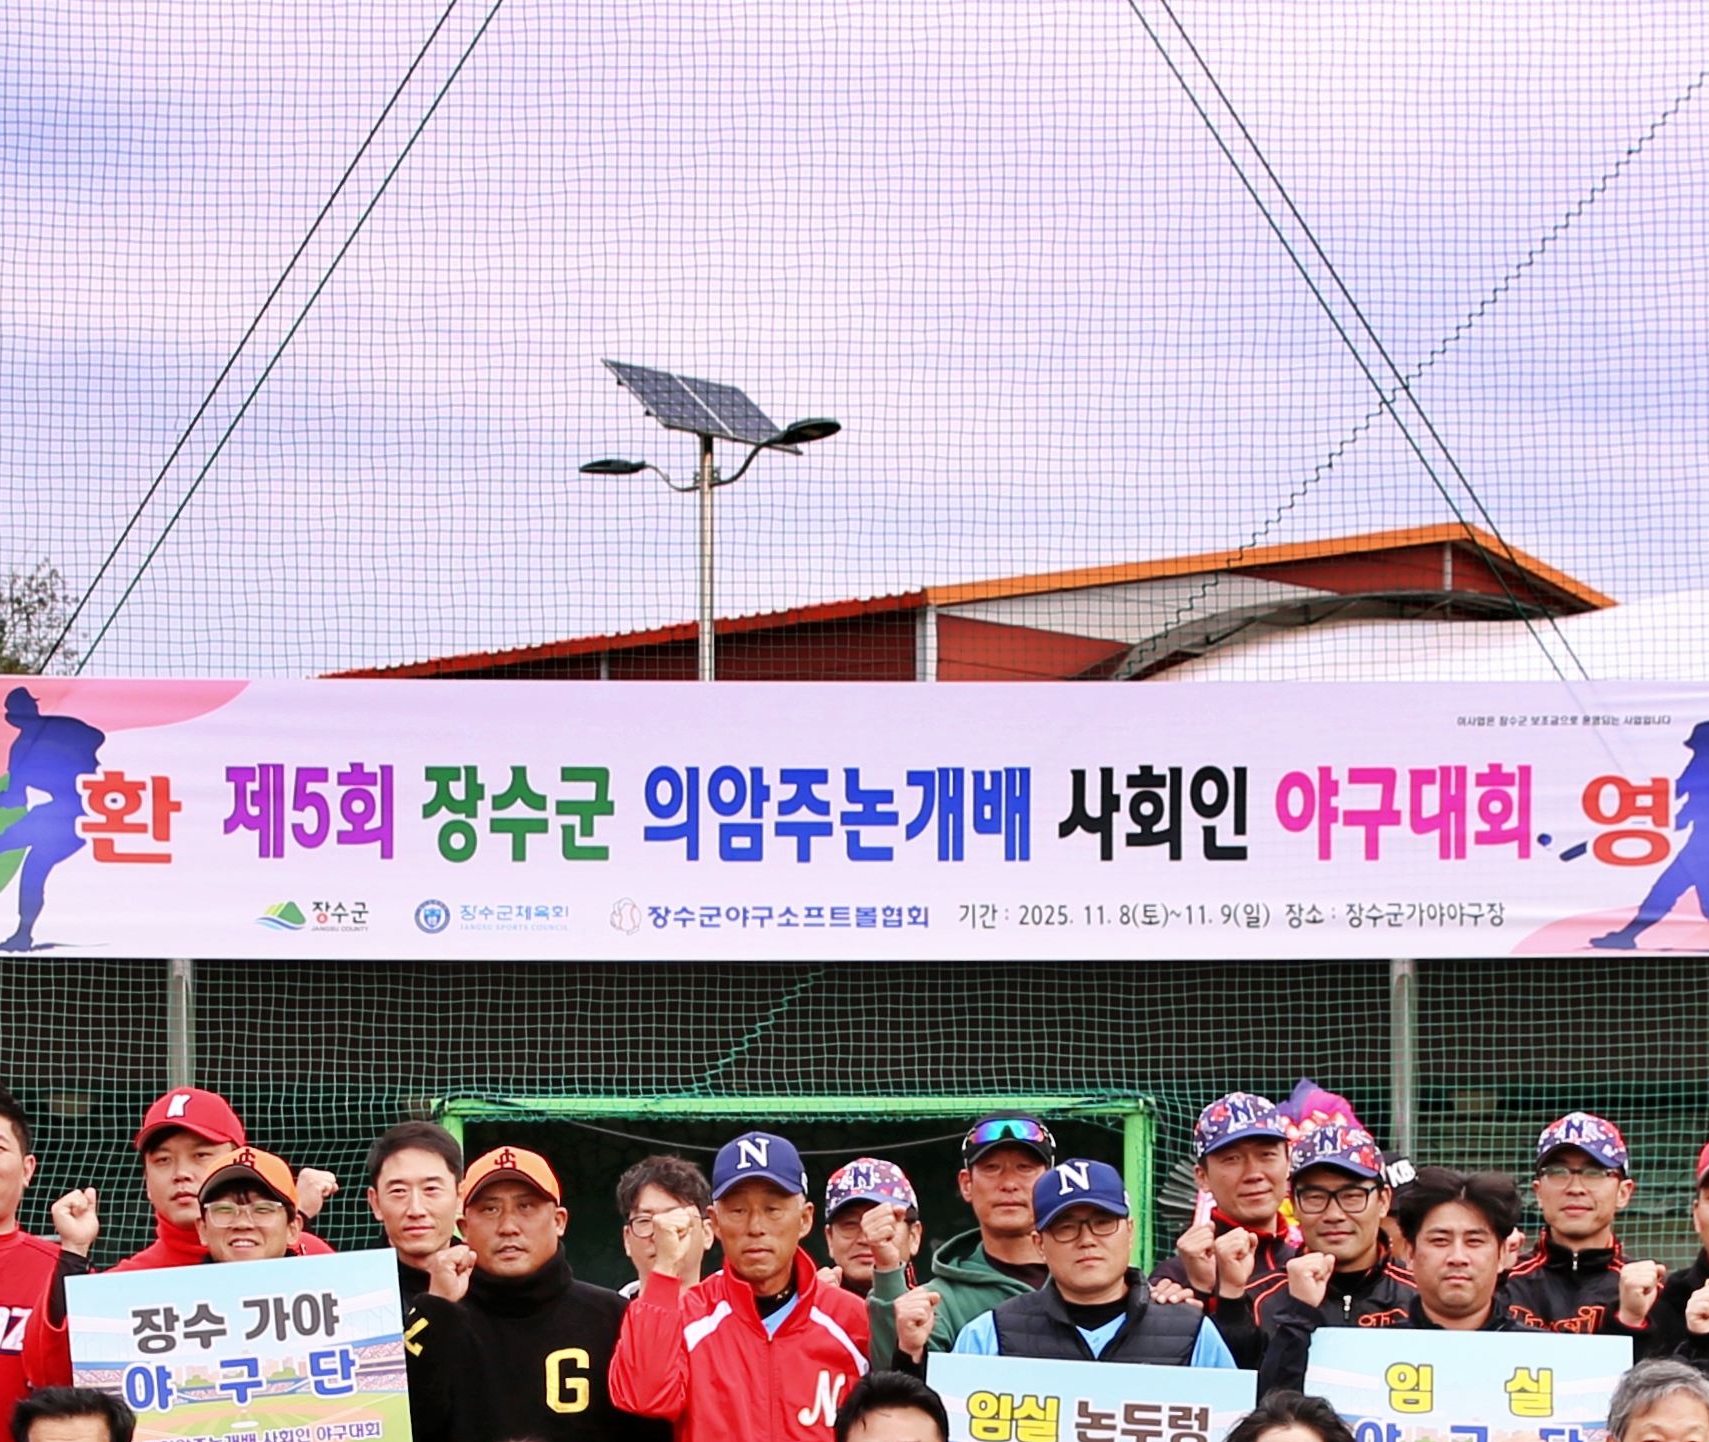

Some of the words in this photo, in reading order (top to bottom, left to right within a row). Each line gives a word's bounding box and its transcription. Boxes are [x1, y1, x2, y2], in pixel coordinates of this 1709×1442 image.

[1499, 715, 1527, 727] 장수군
[1530, 715, 1579, 727] 보조금으로
[1581, 714, 1621, 726] 운영되는
[1623, 714, 1672, 726] 사업입니다
[80, 770, 183, 864] 환
[223, 762, 395, 860] 제5회
[421, 764, 615, 862] 장수군
[643, 764, 1032, 862] 의암주논개배
[1057, 764, 1249, 862] 사회인
[1274, 762, 1534, 861] 야구대회
[1580, 774, 1672, 867] 영
[311, 901, 370, 924] 장수군
[459, 904, 570, 922] 장수군체육회
[647, 905, 930, 928] 장수군야구소프트볼협회
[959, 903, 999, 929] 기간
[1018, 904, 1075, 925] 2025.
[1083, 904, 1112, 925] 11.
[1220, 902, 1271, 928] 9(일)
[1285, 902, 1325, 928] 장소
[1344, 902, 1506, 928] 장수군가야야구장
[529, 923, 570, 931] COUNCIL
[166, 1094, 192, 1117] K
[1228, 1098, 1257, 1124] N
[1315, 1127, 1342, 1154] N
[1561, 1118, 1587, 1142] N
[736, 1137, 771, 1170] N
[850, 1163, 878, 1191] N
[1054, 1160, 1091, 1196] N
[131, 1303, 228, 1354] 장수
[242, 1292, 340, 1342] 가야
[545, 1347, 590, 1414] G
[799, 1370, 845, 1428] N
[315, 1421, 381, 1441] 야구대회
